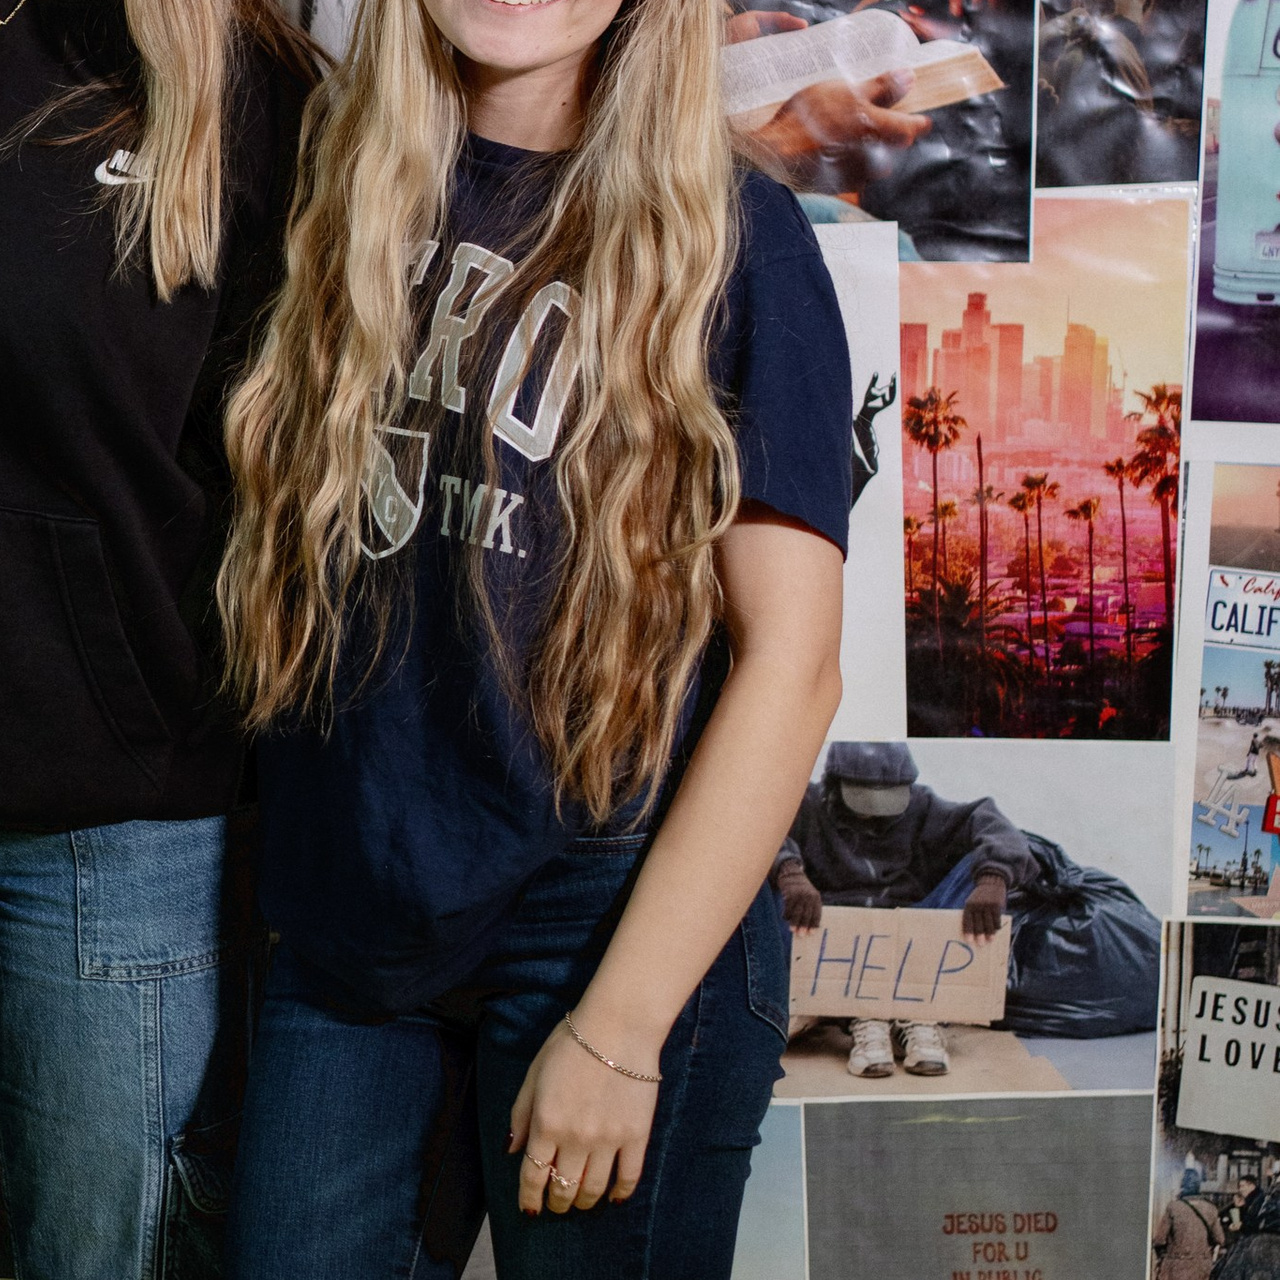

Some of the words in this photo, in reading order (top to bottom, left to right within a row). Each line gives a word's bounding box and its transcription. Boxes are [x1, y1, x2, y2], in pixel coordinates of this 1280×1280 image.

[440, 474, 527, 558] TMK.
[1211, 600, 1280, 637] CALIF
[811, 928, 974, 1003] HELP
[1198, 1033, 1280, 1073] LOVE
[942, 1212, 1007, 1235] JESUS
[1013, 1211, 1058, 1234] DIED
[972, 1241, 1009, 1263] FOR
[1015, 1241, 1029, 1262] U
